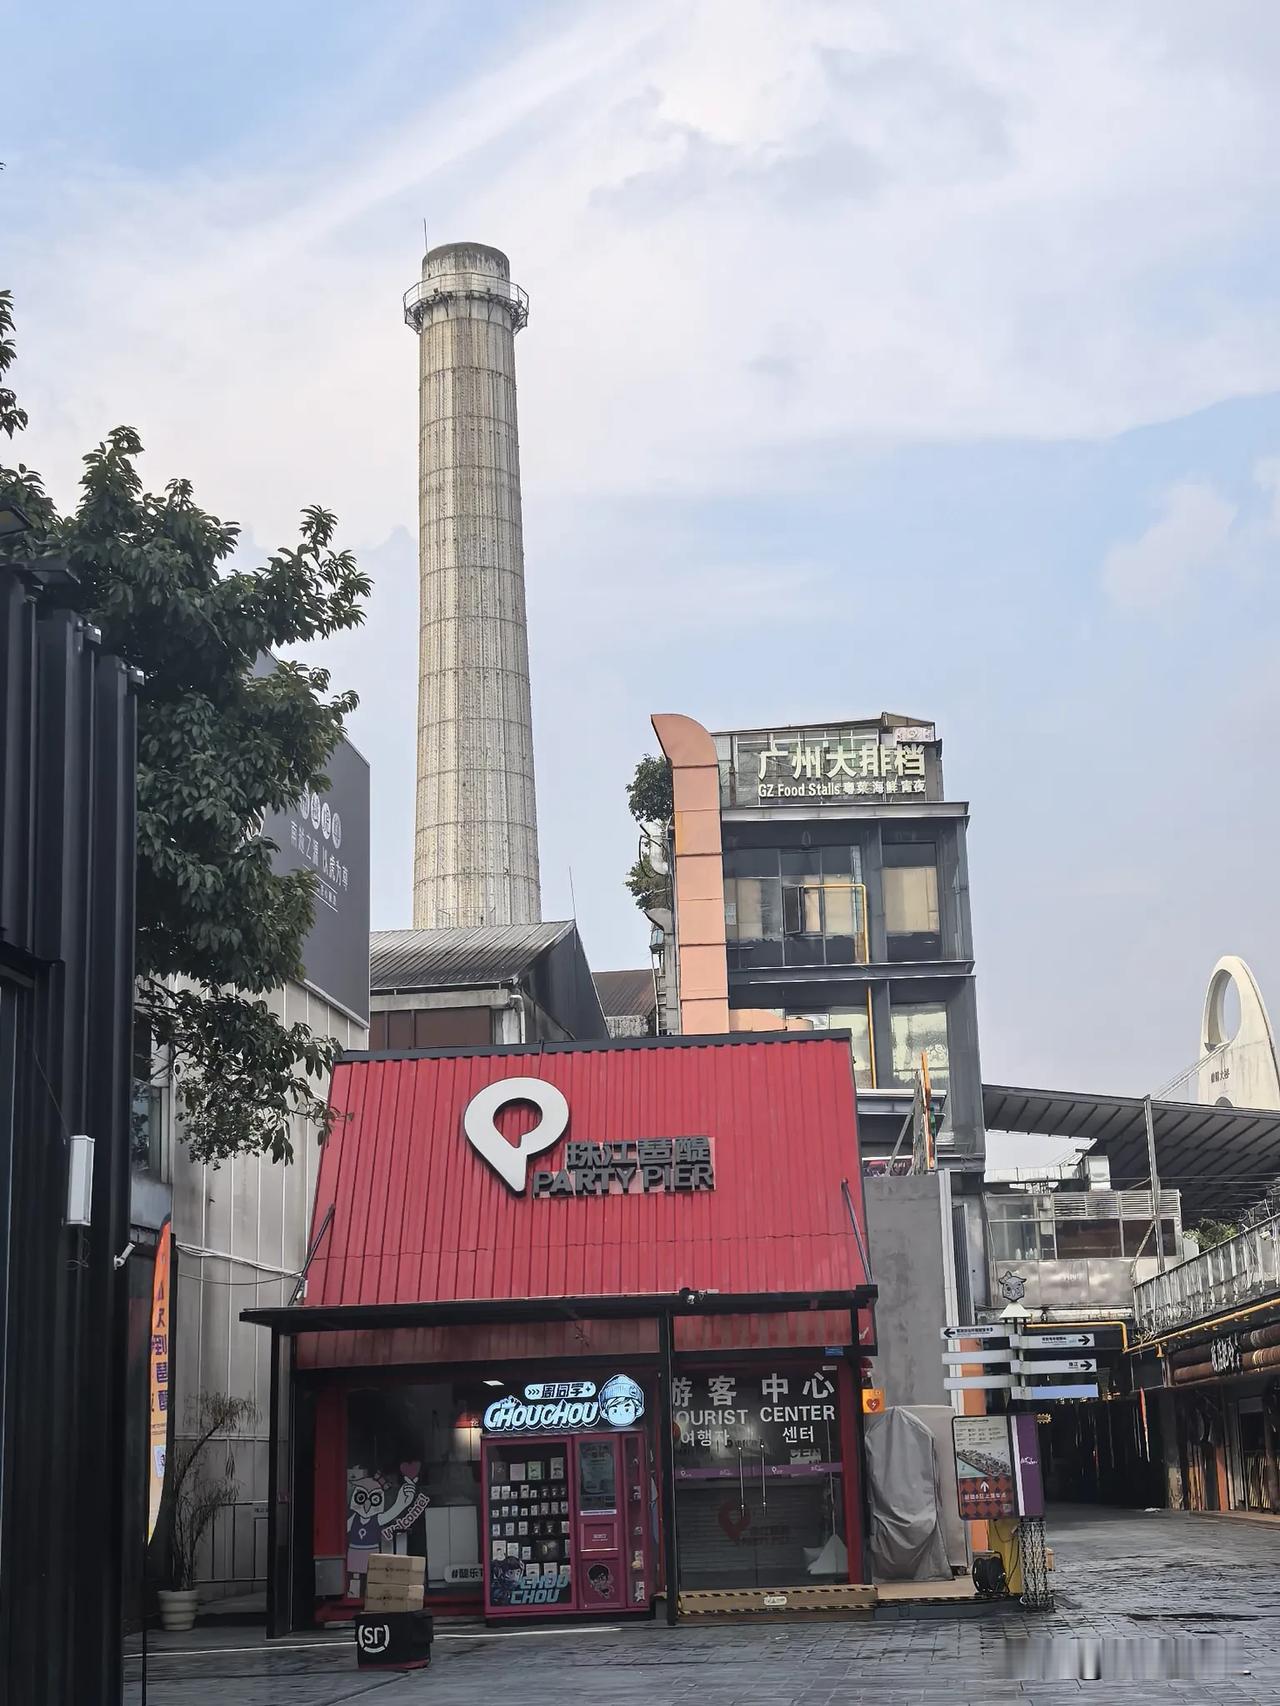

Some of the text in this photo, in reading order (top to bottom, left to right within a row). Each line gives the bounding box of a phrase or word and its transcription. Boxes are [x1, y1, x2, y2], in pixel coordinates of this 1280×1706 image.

[758, 744, 925, 779] 广州大排档
[758, 781, 841, 798] GZ Food Stalls
[567, 1137, 712, 1169] 珠江琶醍
[534, 1165, 714, 1197] PARTY PIER
[541, 1382, 584, 1399] 周同学
[484, 1399, 600, 1431] CHOUCHOU
[674, 1405, 836, 1426] OURIST CENTER
[782, 1425, 815, 1444] 센터
[510, 1588, 561, 1605] CHOU
